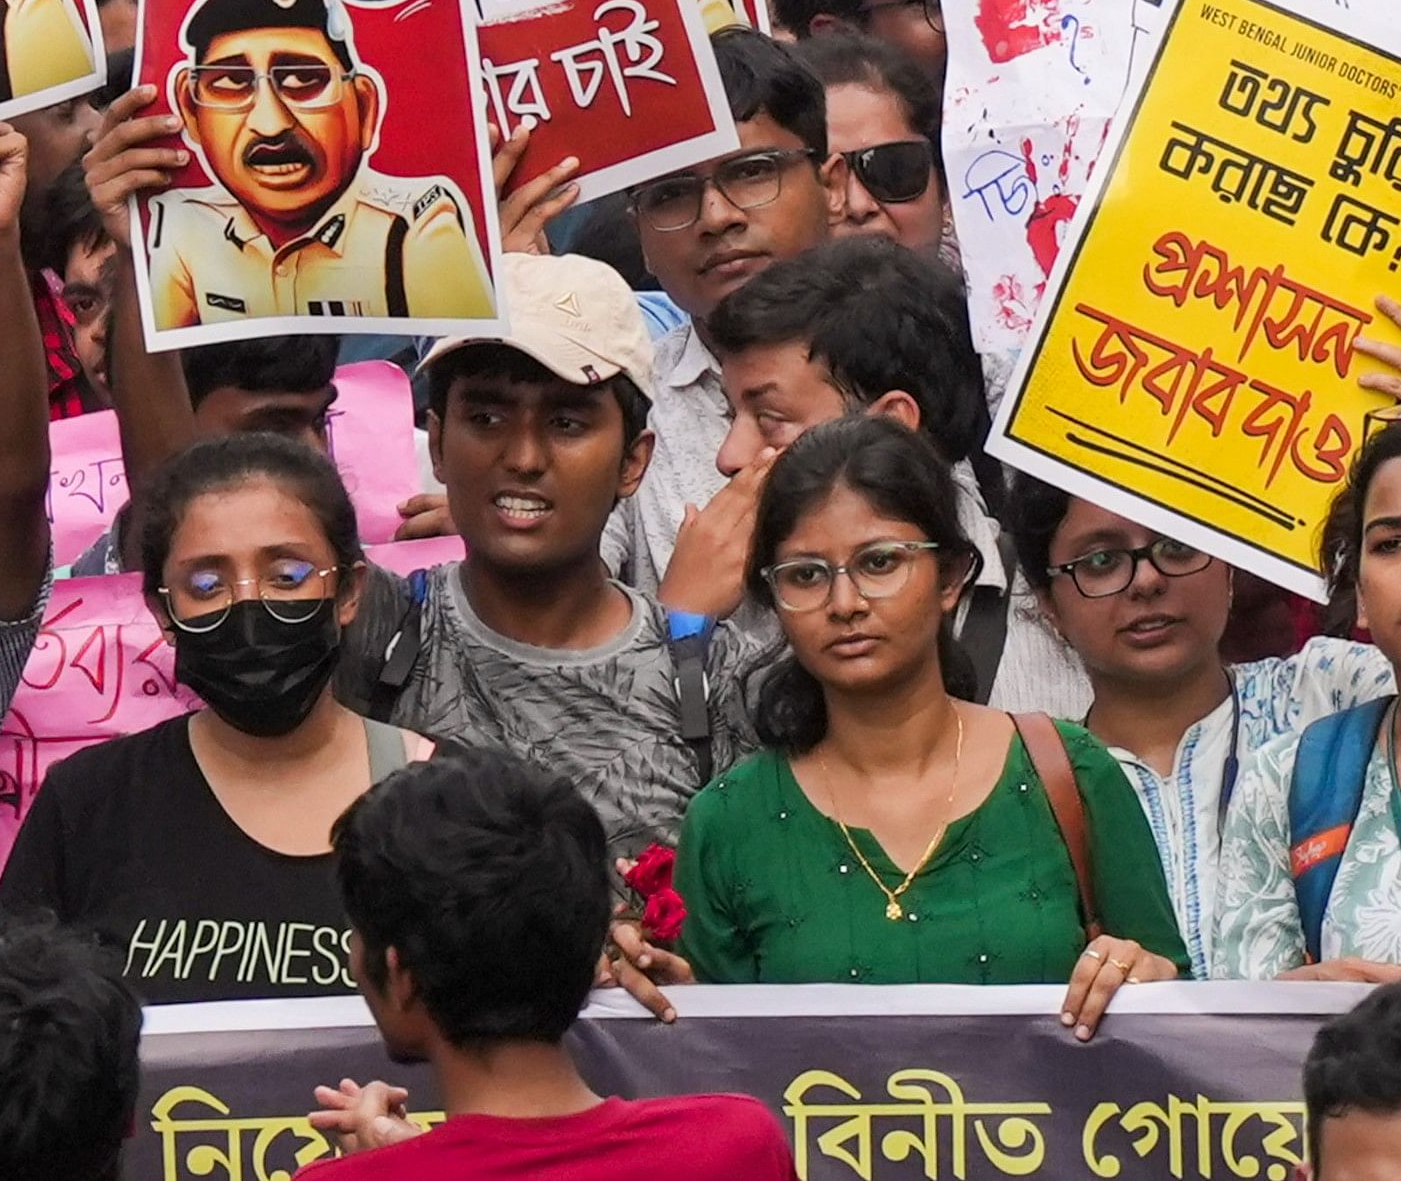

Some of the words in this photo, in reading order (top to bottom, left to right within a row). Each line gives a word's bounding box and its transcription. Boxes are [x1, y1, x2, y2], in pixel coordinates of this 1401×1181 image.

[1199, 3, 1237, 35] WEST
[1238, 17, 1288, 56] BENGAL
[1292, 41, 1339, 76] JUNIOR
[1217, 58, 1332, 145] তথ্য
[1157, 120, 1316, 228] করছে
[1144, 228, 1372, 378] প্রশাসন
[1072, 302, 1250, 447] জবাব
[1249, 378, 1354, 492] দাও
[121, 919, 358, 990] HAPPINESS
[783, 1068, 1053, 1181] বিনীত
